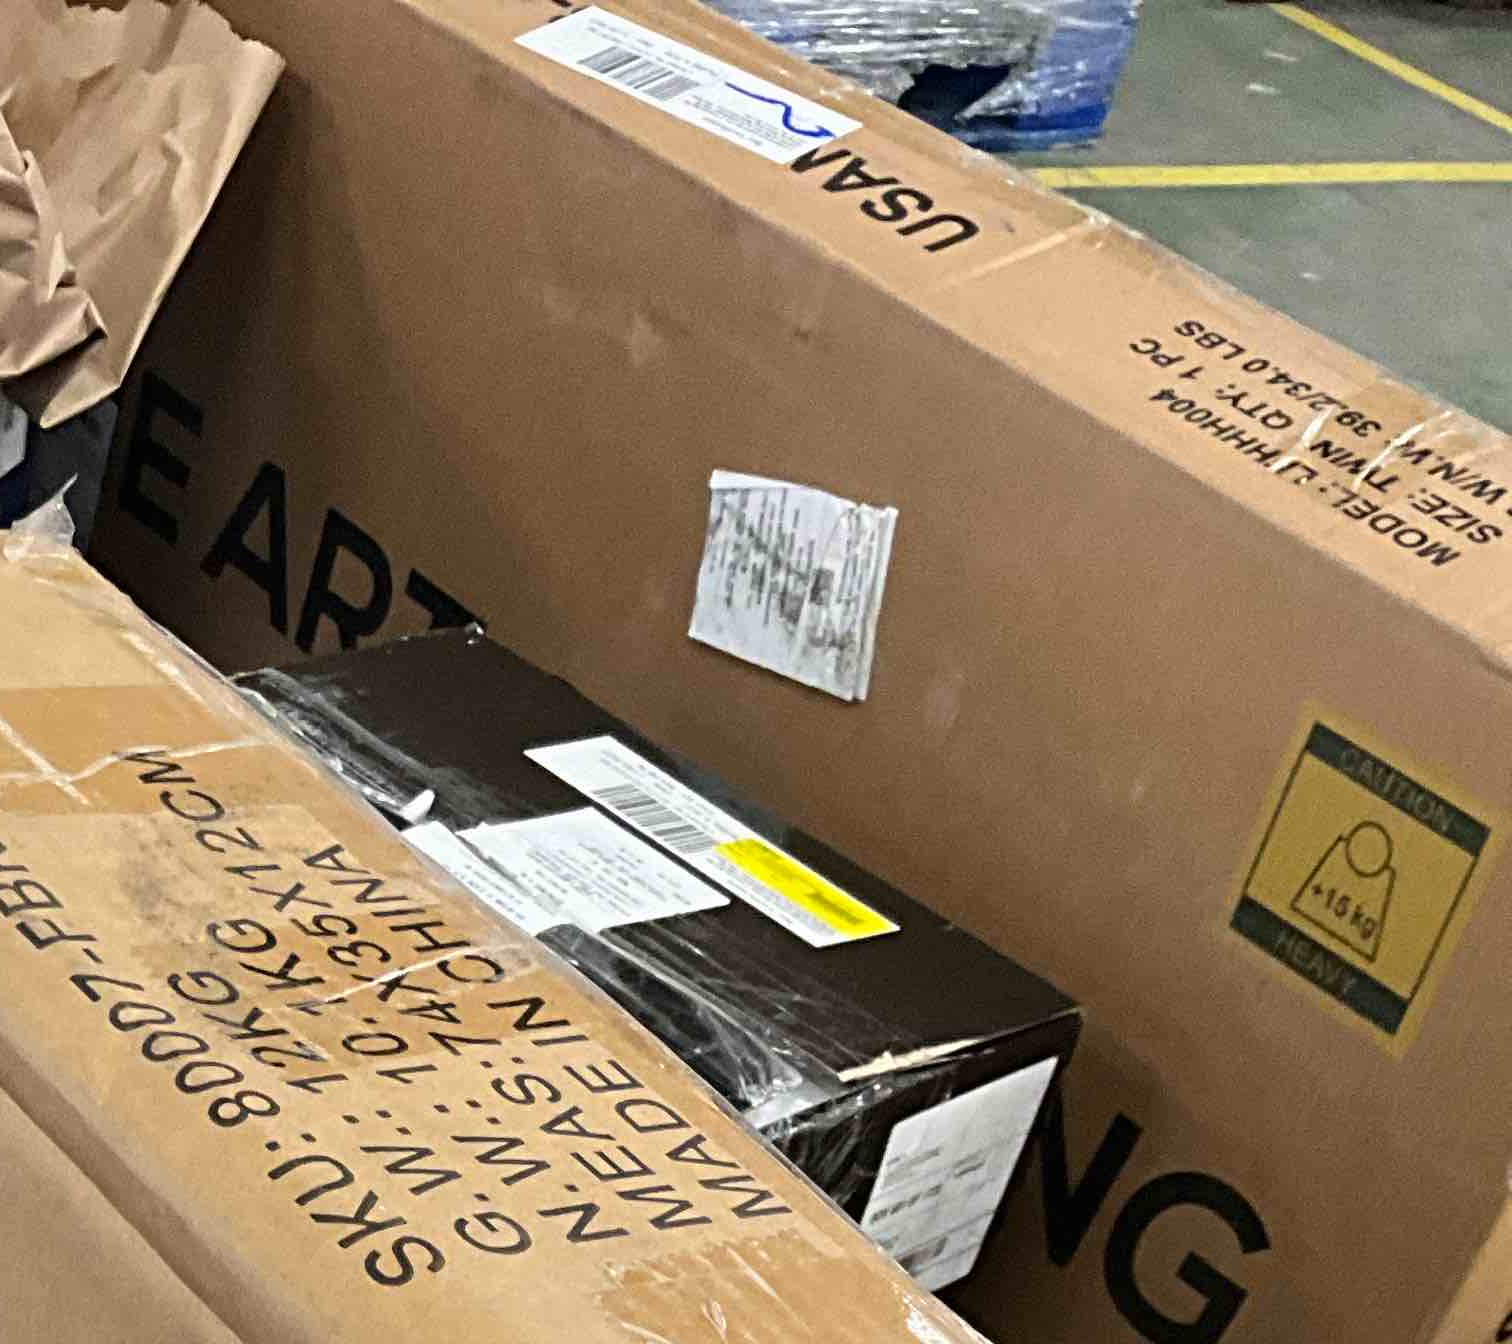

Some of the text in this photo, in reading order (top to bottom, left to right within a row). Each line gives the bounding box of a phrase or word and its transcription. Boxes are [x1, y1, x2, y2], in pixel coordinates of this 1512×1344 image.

[1174, 319, 1247, 360] LBS
[1129, 337, 1504, 545] SIZE: TWIN QTY: 1 PC
[1319, 481, 1461, 567] MODEL:
[1338, 747, 1457, 832] CAUTION
[304, 843, 508, 983] CHINA
[1272, 926, 1358, 995] HEAVY
[1350, 899, 1378, 940] kg
[167, 969, 349, 1094] 12KG
[207, 918, 438, 1085] 10.1KG
[488, 996, 590, 1043] IN
[572, 1059, 793, 1217] MADE
[265, 1133, 447, 1287] SKU:
